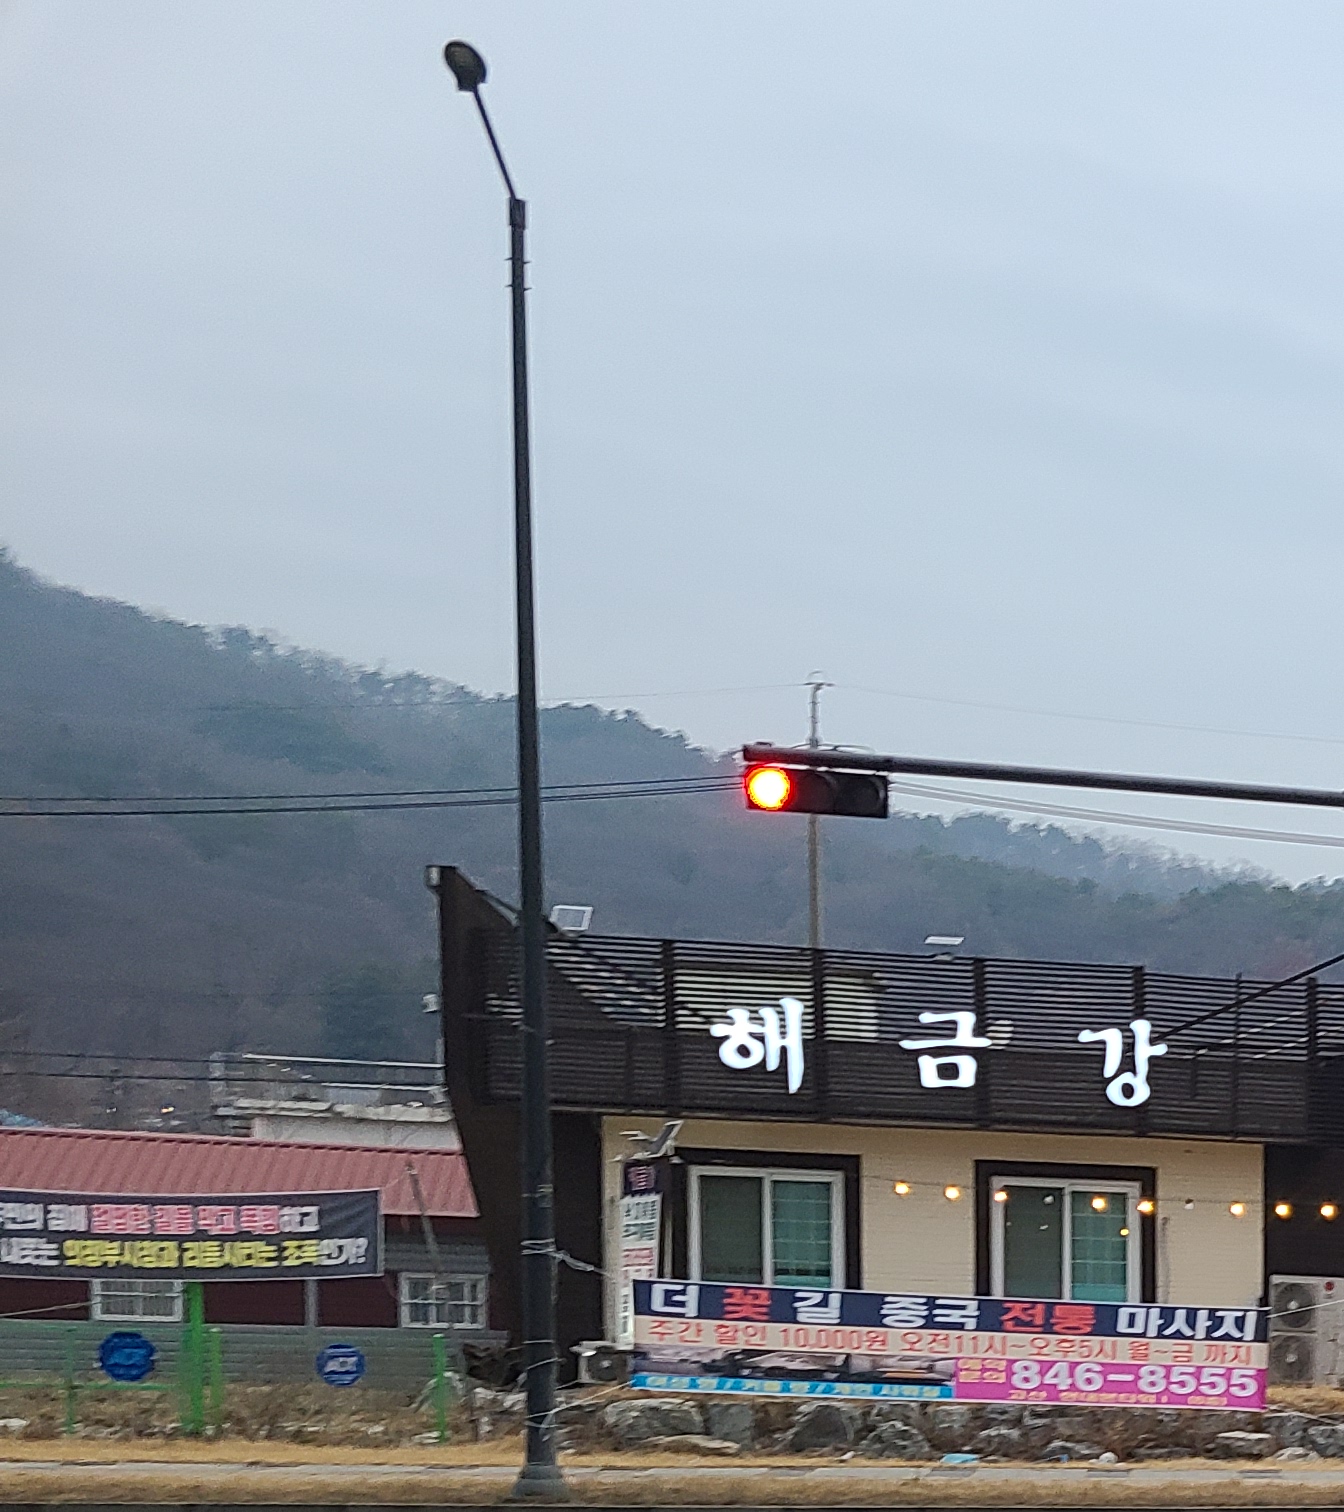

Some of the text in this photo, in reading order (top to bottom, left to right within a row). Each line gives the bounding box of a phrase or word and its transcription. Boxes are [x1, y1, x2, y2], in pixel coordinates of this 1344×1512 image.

[651, 1283, 700, 1318] 더
[723, 1287, 772, 1321] 꽃
[793, 1291, 843, 1324] 길
[879, 1296, 981, 1330] 중국
[1000, 1302, 1096, 1334] 전통
[1116, 1306, 1258, 1341] 마사지
[648, 1320, 1252, 1365] 주간 할인 10,000원 오전11시~오후5시 월~금 까지
[1010, 1360, 1258, 1398] 846-8555
